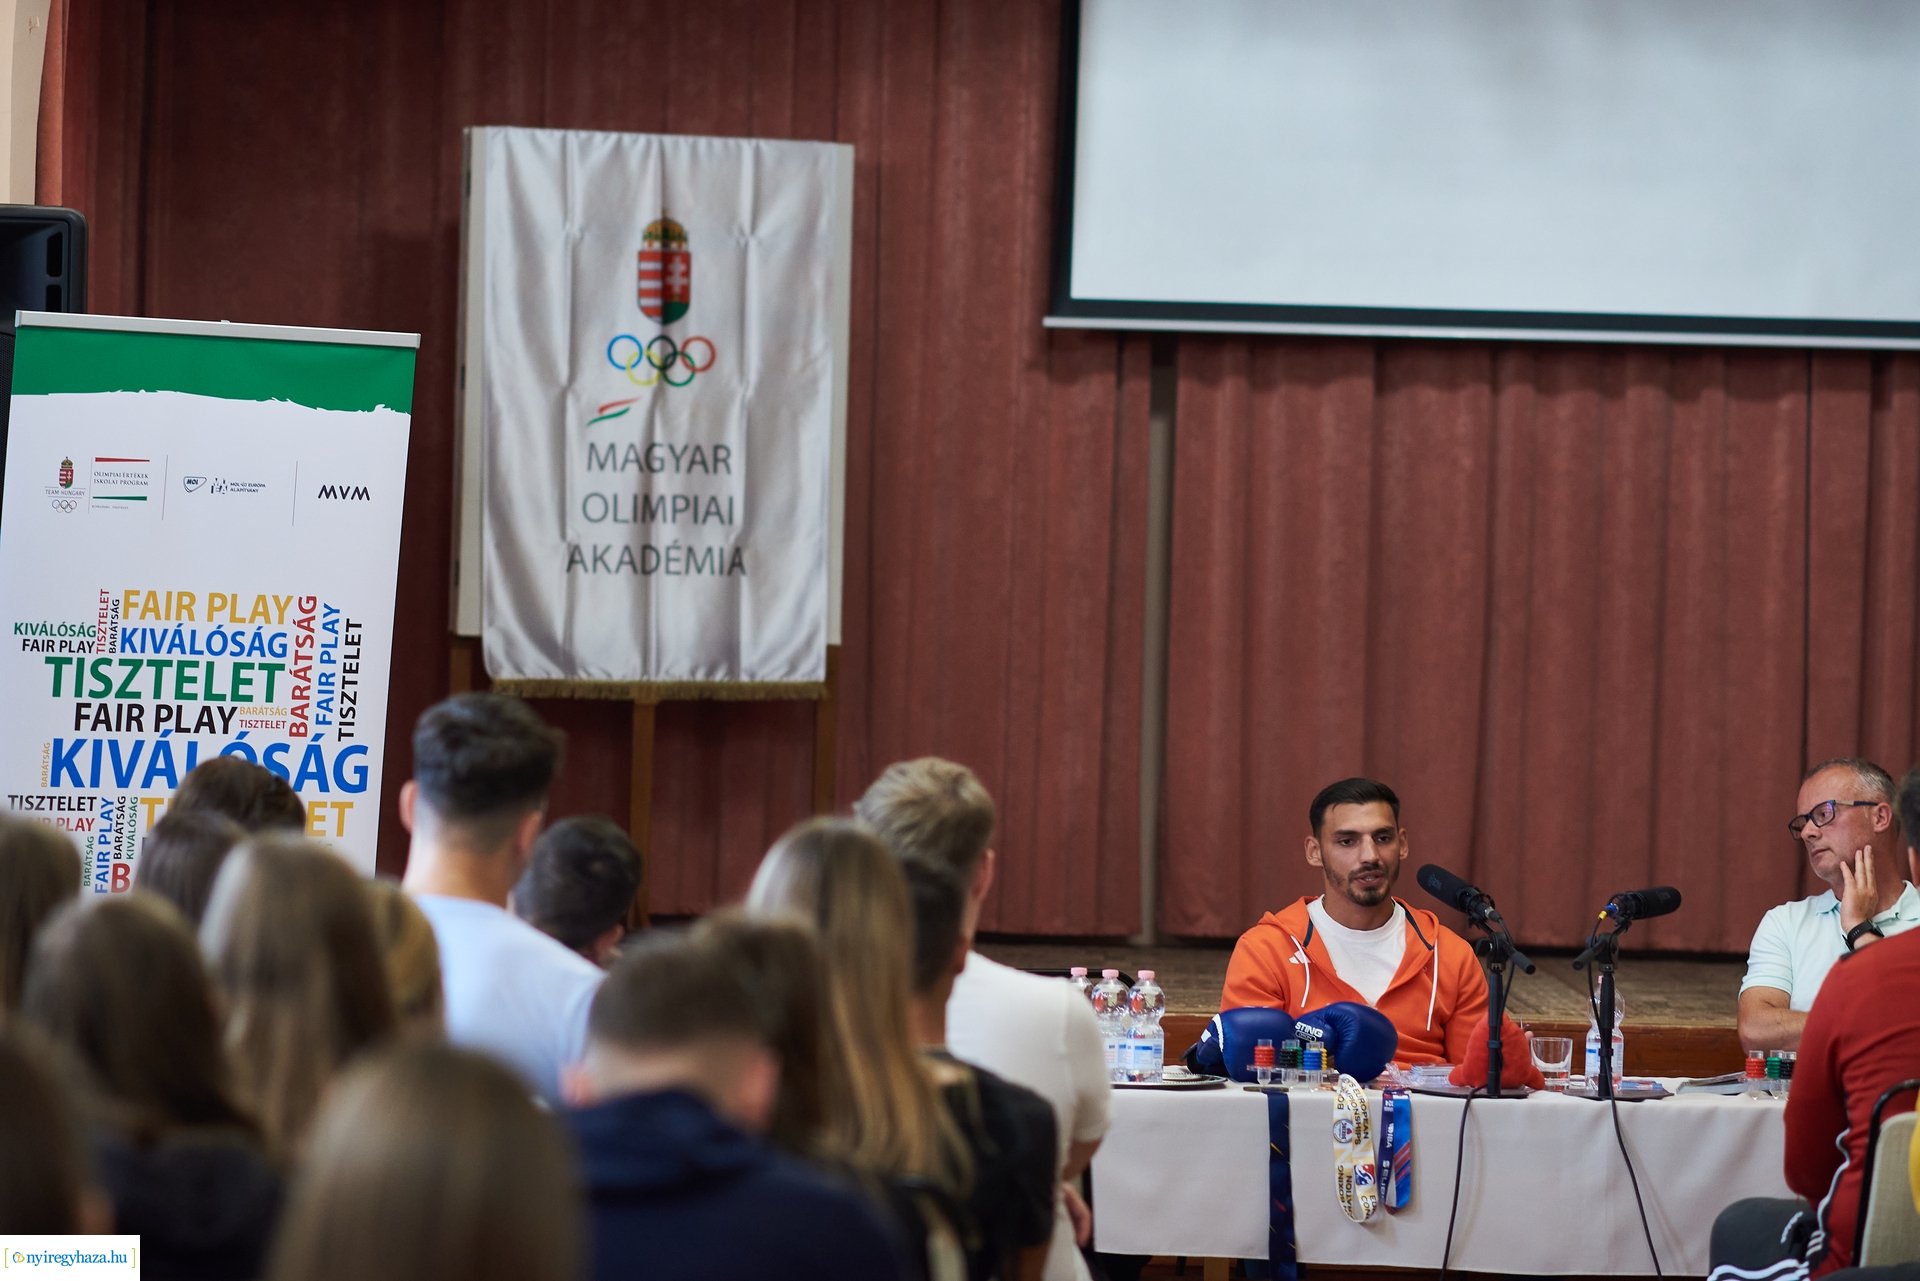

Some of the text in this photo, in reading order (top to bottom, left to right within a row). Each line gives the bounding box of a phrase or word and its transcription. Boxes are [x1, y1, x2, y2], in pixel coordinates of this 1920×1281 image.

[122, 471, 149, 479] ÉRTÉKEK
[586, 442, 731, 475] MAGYAR
[317, 485, 370, 501] MVM
[582, 492, 734, 526] OLIMPIAI
[566, 539, 747, 576] AKADÉMIA
[96, 588, 109, 654] TISZTELET
[122, 589, 294, 625] FAIR PLAY
[14, 621, 96, 638] KIVÁLÓSÁG
[109, 599, 120, 654] BARÁTSÁG
[120, 623, 288, 658] KIVÁLÓSÁG
[22, 639, 95, 654] FAIR PLAY
[315, 602, 340, 725] FAIR PLAY
[45, 656, 285, 703] TISZTELET
[289, 595, 317, 737] BARÁTSÁG
[338, 618, 362, 742] TISZTELET
[74, 702, 238, 734] FAIR PLAY
[239, 706, 287, 716] BARÁTSÁG
[239, 719, 287, 730] TISZTELET
[41, 742, 50, 788] BARÁTSÁG
[8, 794, 97, 812] TISZTELET
[95, 797, 114, 894] FAIR PLAY
[113, 795, 126, 860] BARÁTSÁG
[126, 796, 138, 860] KIVÁLÓSÁG
[83, 836, 94, 887] BARÁTSÁG
[1295, 1021, 1323, 1038] STING
[1353, 1088, 1369, 1139] EUROPEAN
